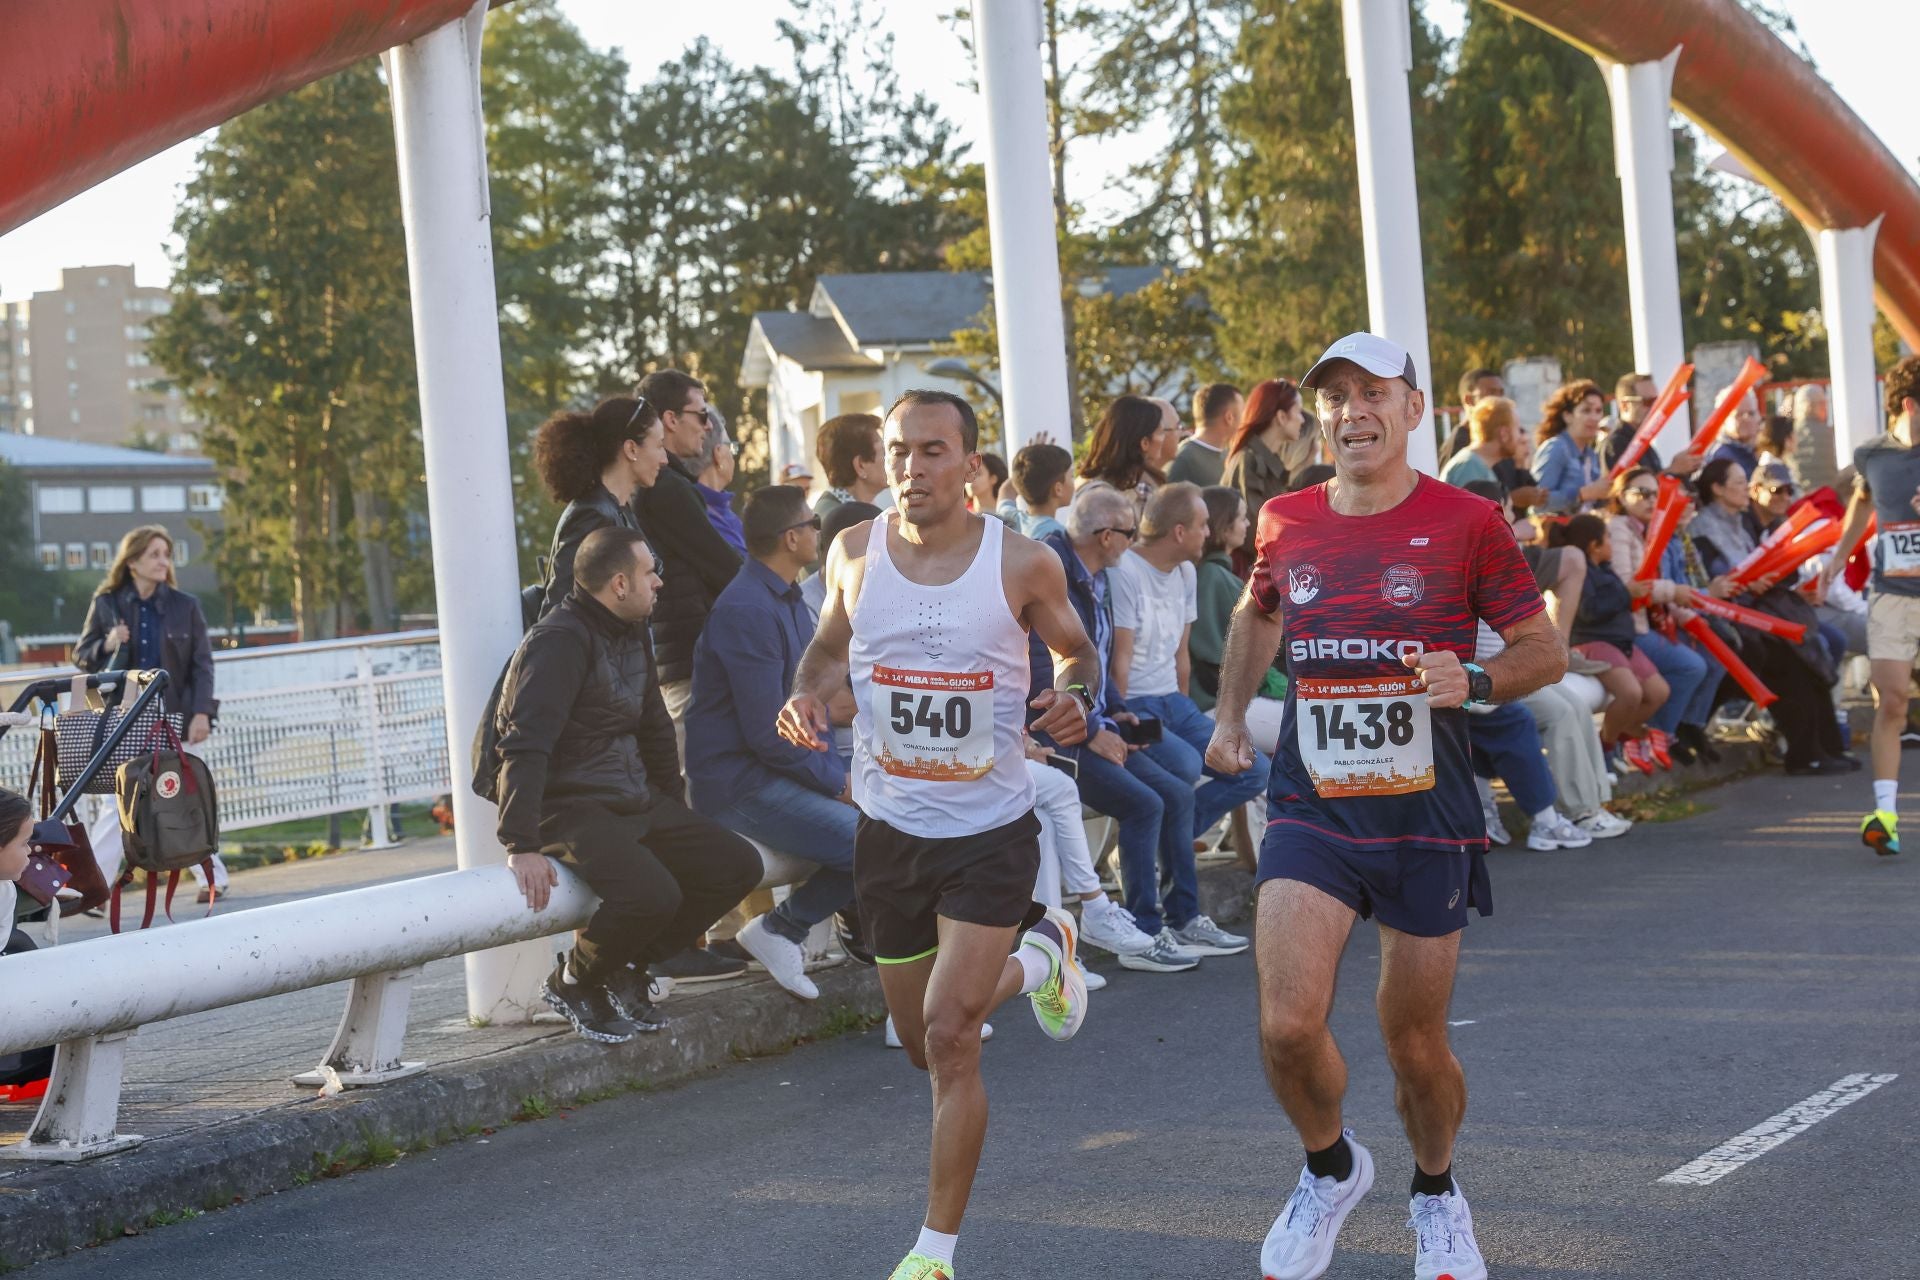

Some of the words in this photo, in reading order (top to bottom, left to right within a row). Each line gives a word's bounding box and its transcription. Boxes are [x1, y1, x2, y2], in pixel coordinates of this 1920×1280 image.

[1290, 638, 1424, 662] SIROKO
[904, 675, 929, 684] MBA
[949, 678, 976, 687] GIJÓN
[1330, 685, 1356, 694] MBA
[1378, 681, 1406, 692] GIJÓN
[891, 692, 971, 738] 540
[1309, 701, 1415, 751] 1438
[902, 743, 931, 752] YONATAN
[1355, 757, 1394, 766] GONZÁLEZ
